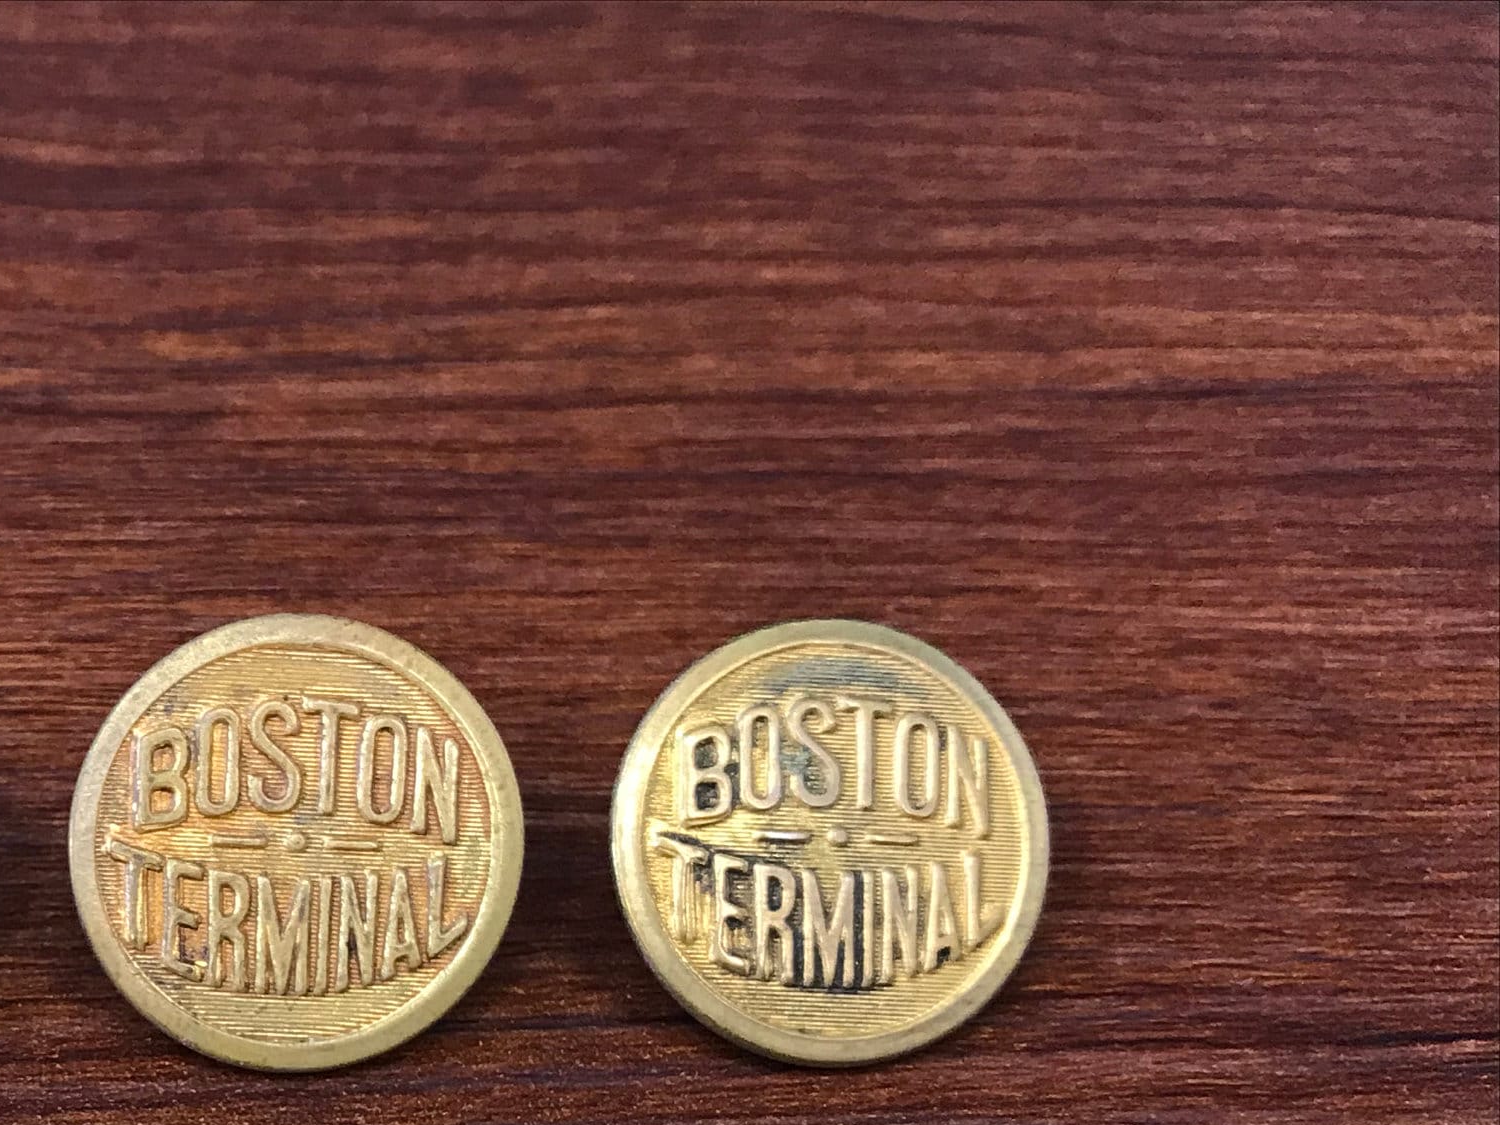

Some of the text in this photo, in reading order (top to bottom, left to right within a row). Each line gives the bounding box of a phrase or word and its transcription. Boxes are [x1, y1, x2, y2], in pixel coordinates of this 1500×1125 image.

[132, 695, 460, 845] BOSTON
[676, 692, 990, 839] BOSTON
[100, 825, 469, 998] TERMINAL
[643, 822, 1006, 991] TERMINAL
